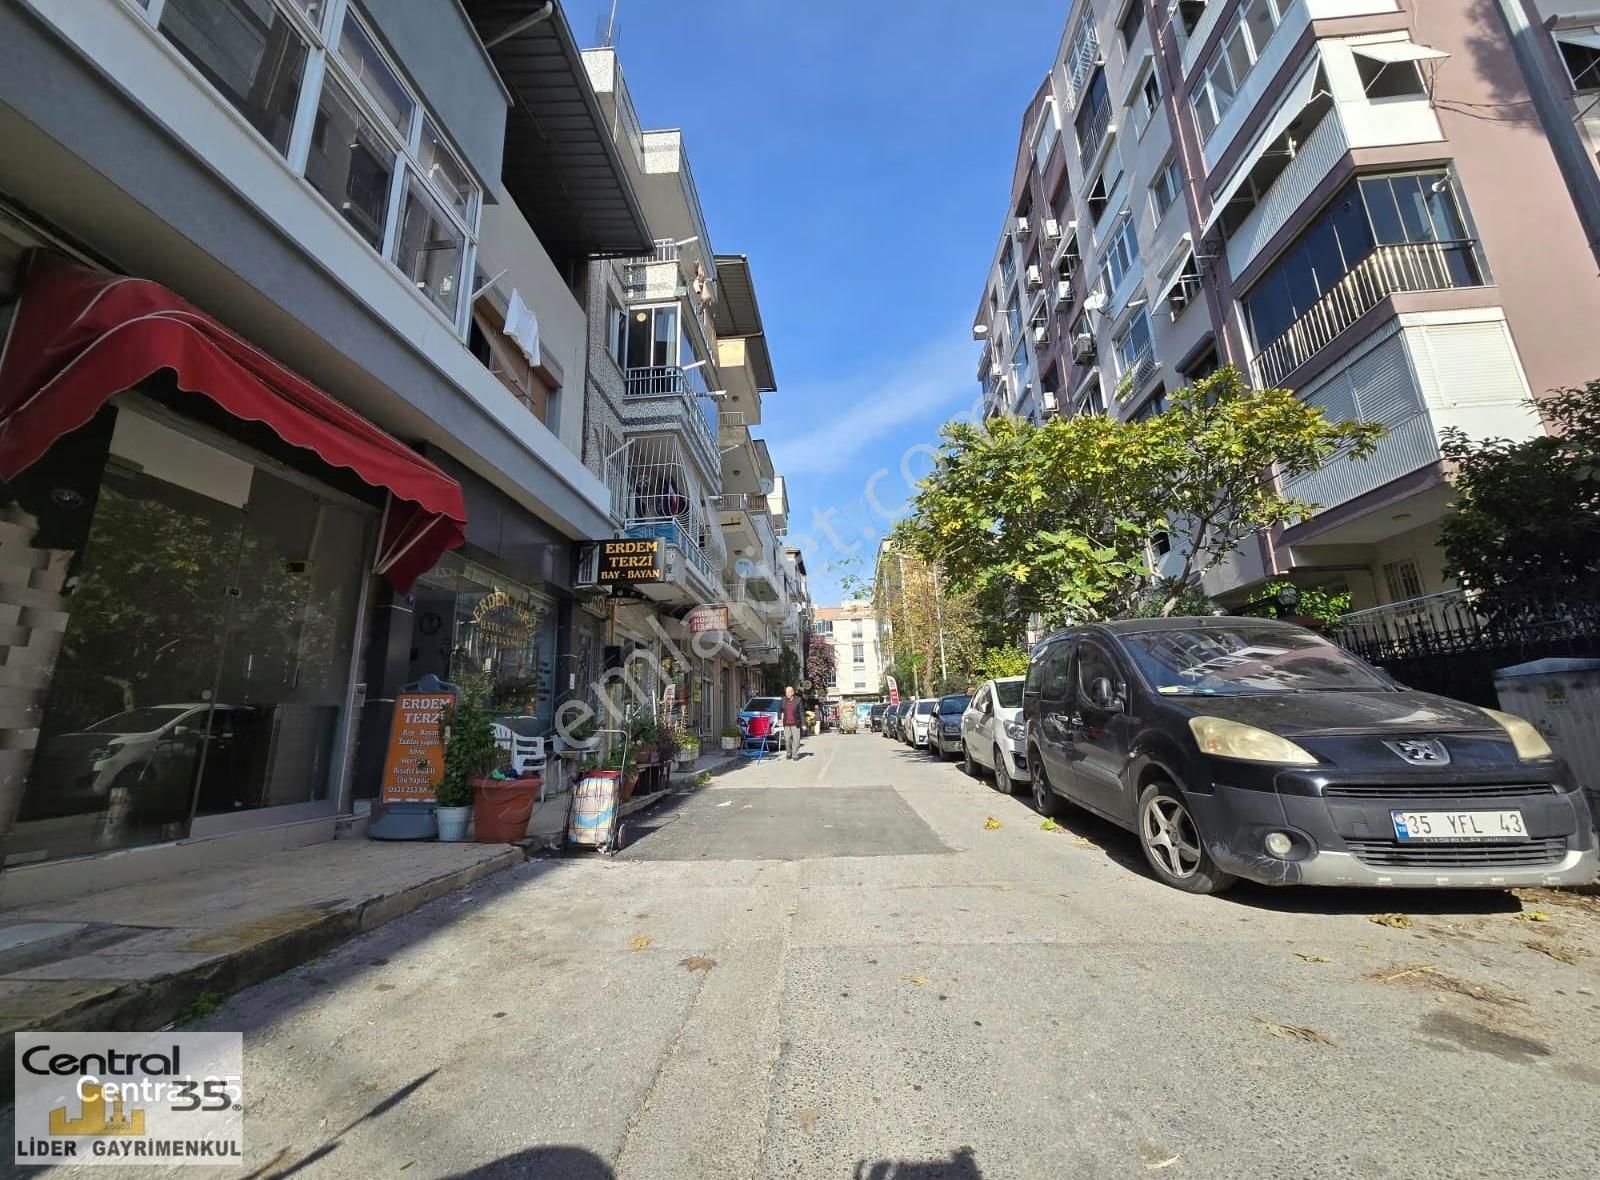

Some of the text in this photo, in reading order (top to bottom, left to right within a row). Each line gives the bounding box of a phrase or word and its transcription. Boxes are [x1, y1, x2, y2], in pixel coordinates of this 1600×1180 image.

[605, 541, 658, 554] ERDEM
[609, 553, 654, 568] TERZİ
[601, 571, 620, 580] BAY
[627, 569, 660, 579] BAYAN
[473, 591, 513, 622] ERDEM
[401, 698, 451, 709] ERDEM
[403, 713, 444, 723] TERZ
[1408, 813, 1522, 834] 35 YFL 43
